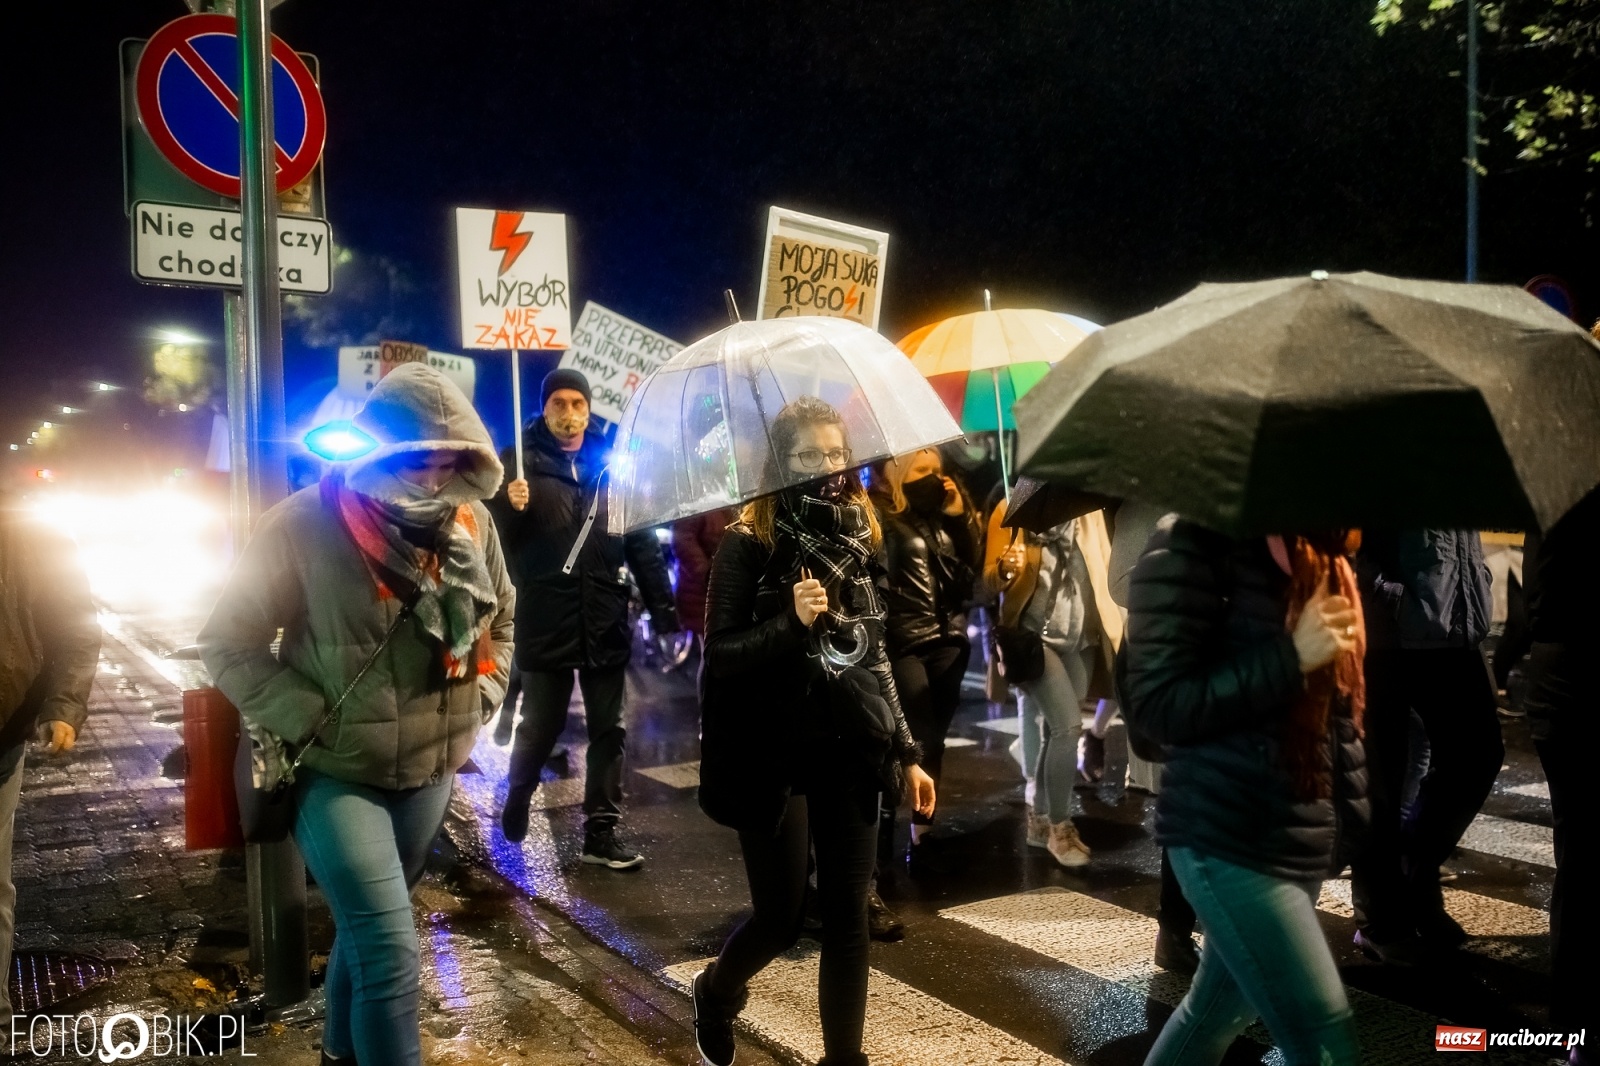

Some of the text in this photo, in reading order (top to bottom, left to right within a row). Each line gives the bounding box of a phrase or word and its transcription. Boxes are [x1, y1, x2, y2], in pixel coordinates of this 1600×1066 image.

[141, 211, 323, 256] Nie doczy
[779, 242, 879, 288] MOJA SUKA
[478, 273, 567, 309] WYBÓR
[504, 308, 542, 327] NIE
[474, 325, 568, 350] ZAKAZ
[572, 328, 592, 348] ZA
[571, 351, 619, 381] MAMY
